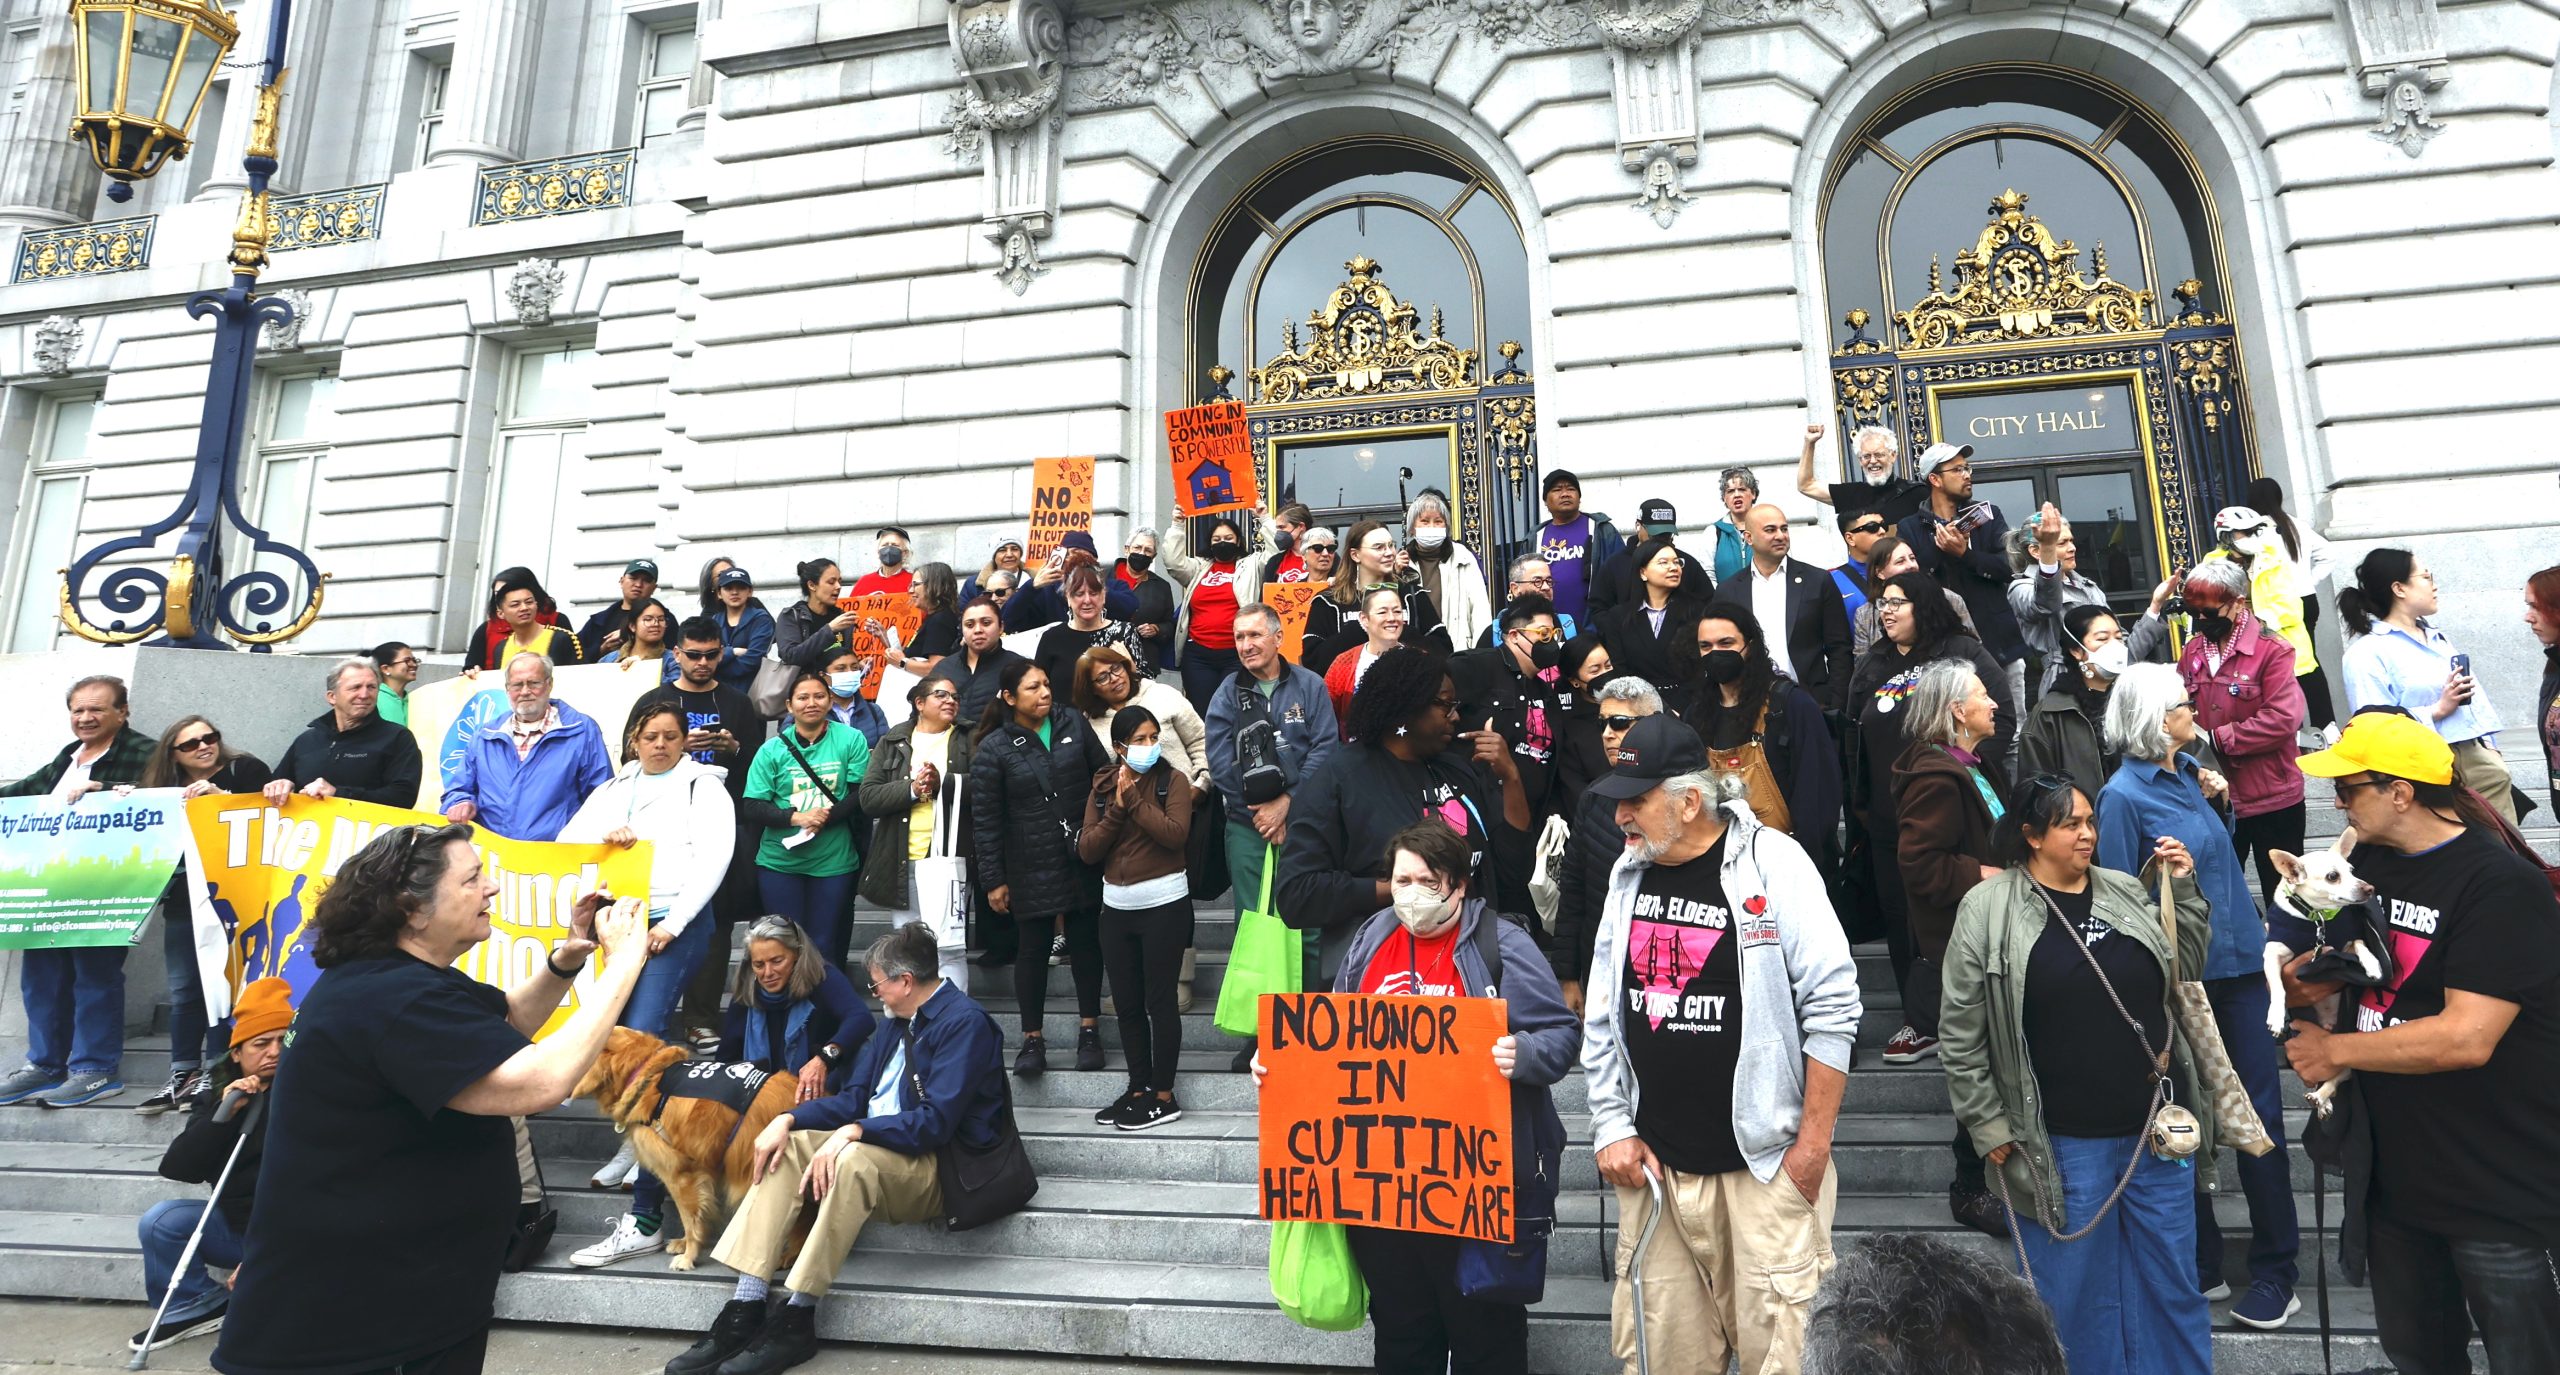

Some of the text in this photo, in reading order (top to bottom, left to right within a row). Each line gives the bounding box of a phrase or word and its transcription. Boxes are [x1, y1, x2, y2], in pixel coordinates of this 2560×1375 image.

[1170, 403, 1242, 429] LIVING IN
[1969, 410, 2106, 437] CITY HALL
[1168, 419, 1247, 443] COMMUNITY
[1172, 436, 1253, 464] IS POWERFUL
[1035, 486, 1071, 510] NO
[1032, 510, 1090, 529] HONOR
[1030, 529, 1041, 541] IN
[866, 598, 893, 611] HAY
[17, 811, 64, 836] Living
[65, 806, 165, 833] Campaign
[218, 807, 320, 871] The
[36, 909, 78, 918] discapacidad
[53, 898, 88, 908] disabilities
[1666, 896, 1728, 929] ELDERS
[2389, 898, 2440, 935] ELDERS
[1646, 991, 1680, 1019] THIS
[1683, 994, 1726, 1021] CITY
[1271, 994, 1460, 1056] NO HONOR
[1666, 1021, 1722, 1033] openhouse
[1337, 1059, 1407, 1105] IN
[1287, 1113, 1502, 1180] CUTTING
[1263, 1166, 1511, 1241] HEALTHCARE
